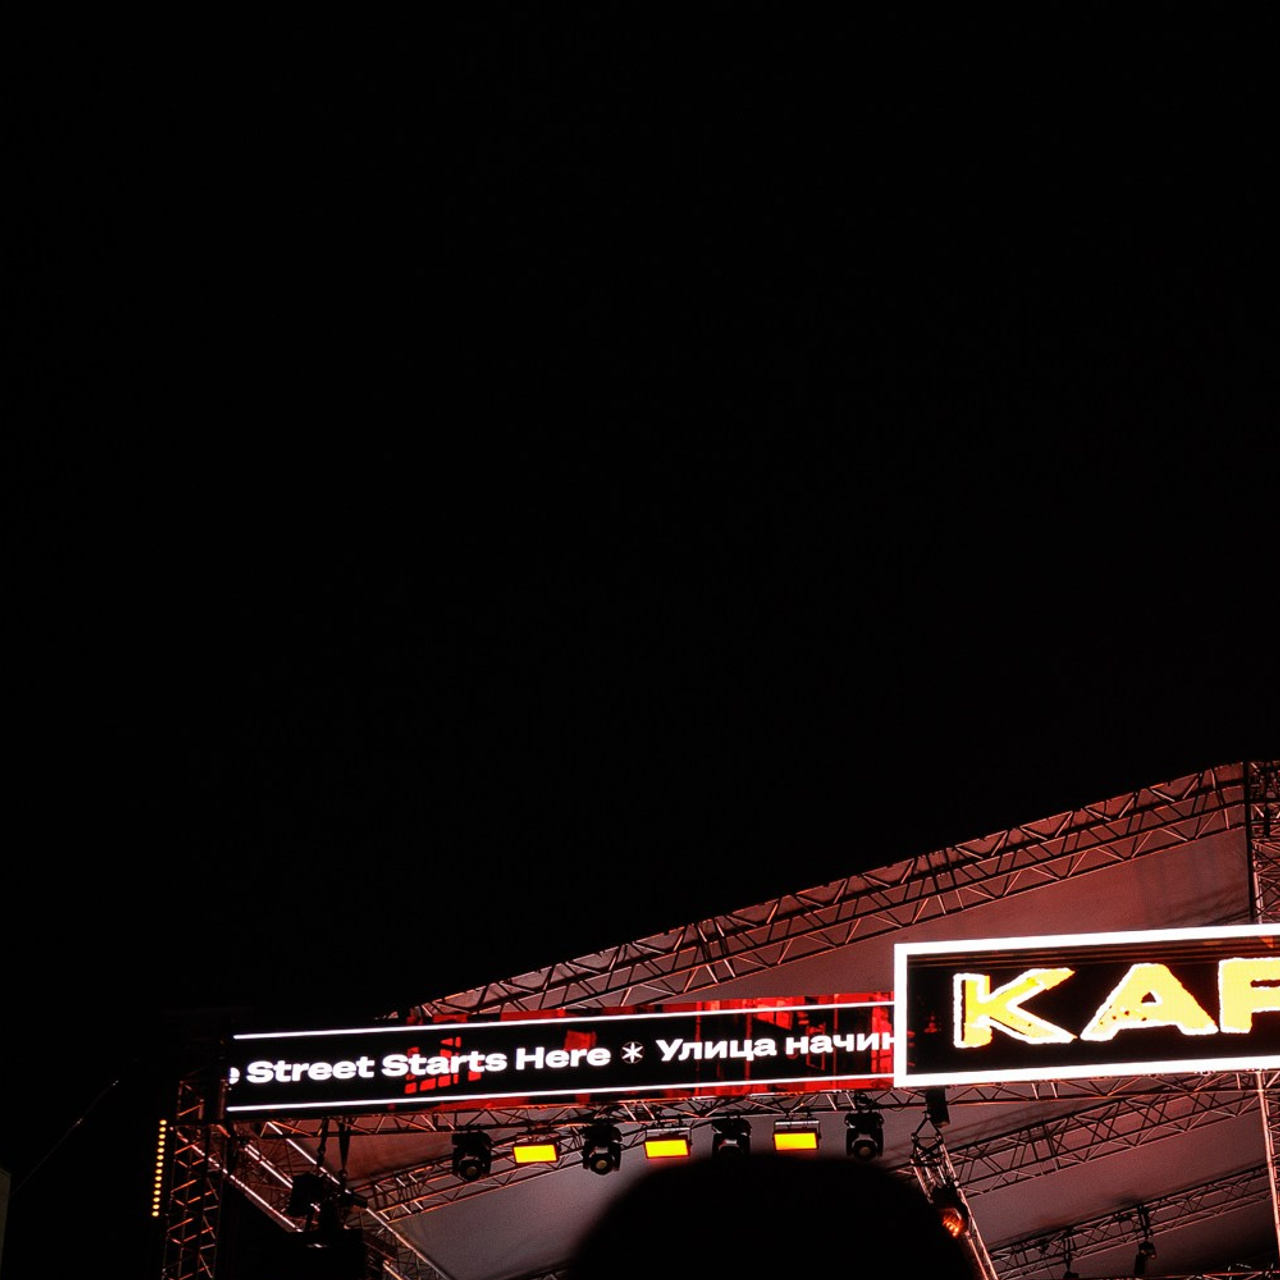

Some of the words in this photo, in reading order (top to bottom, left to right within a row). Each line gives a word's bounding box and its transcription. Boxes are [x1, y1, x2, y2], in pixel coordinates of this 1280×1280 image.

[246, 1056, 375, 1084] Street
[381, 1050, 508, 1077] Starts
[515, 1046, 611, 1070] Here
[656, 1038, 778, 1062] Улица
